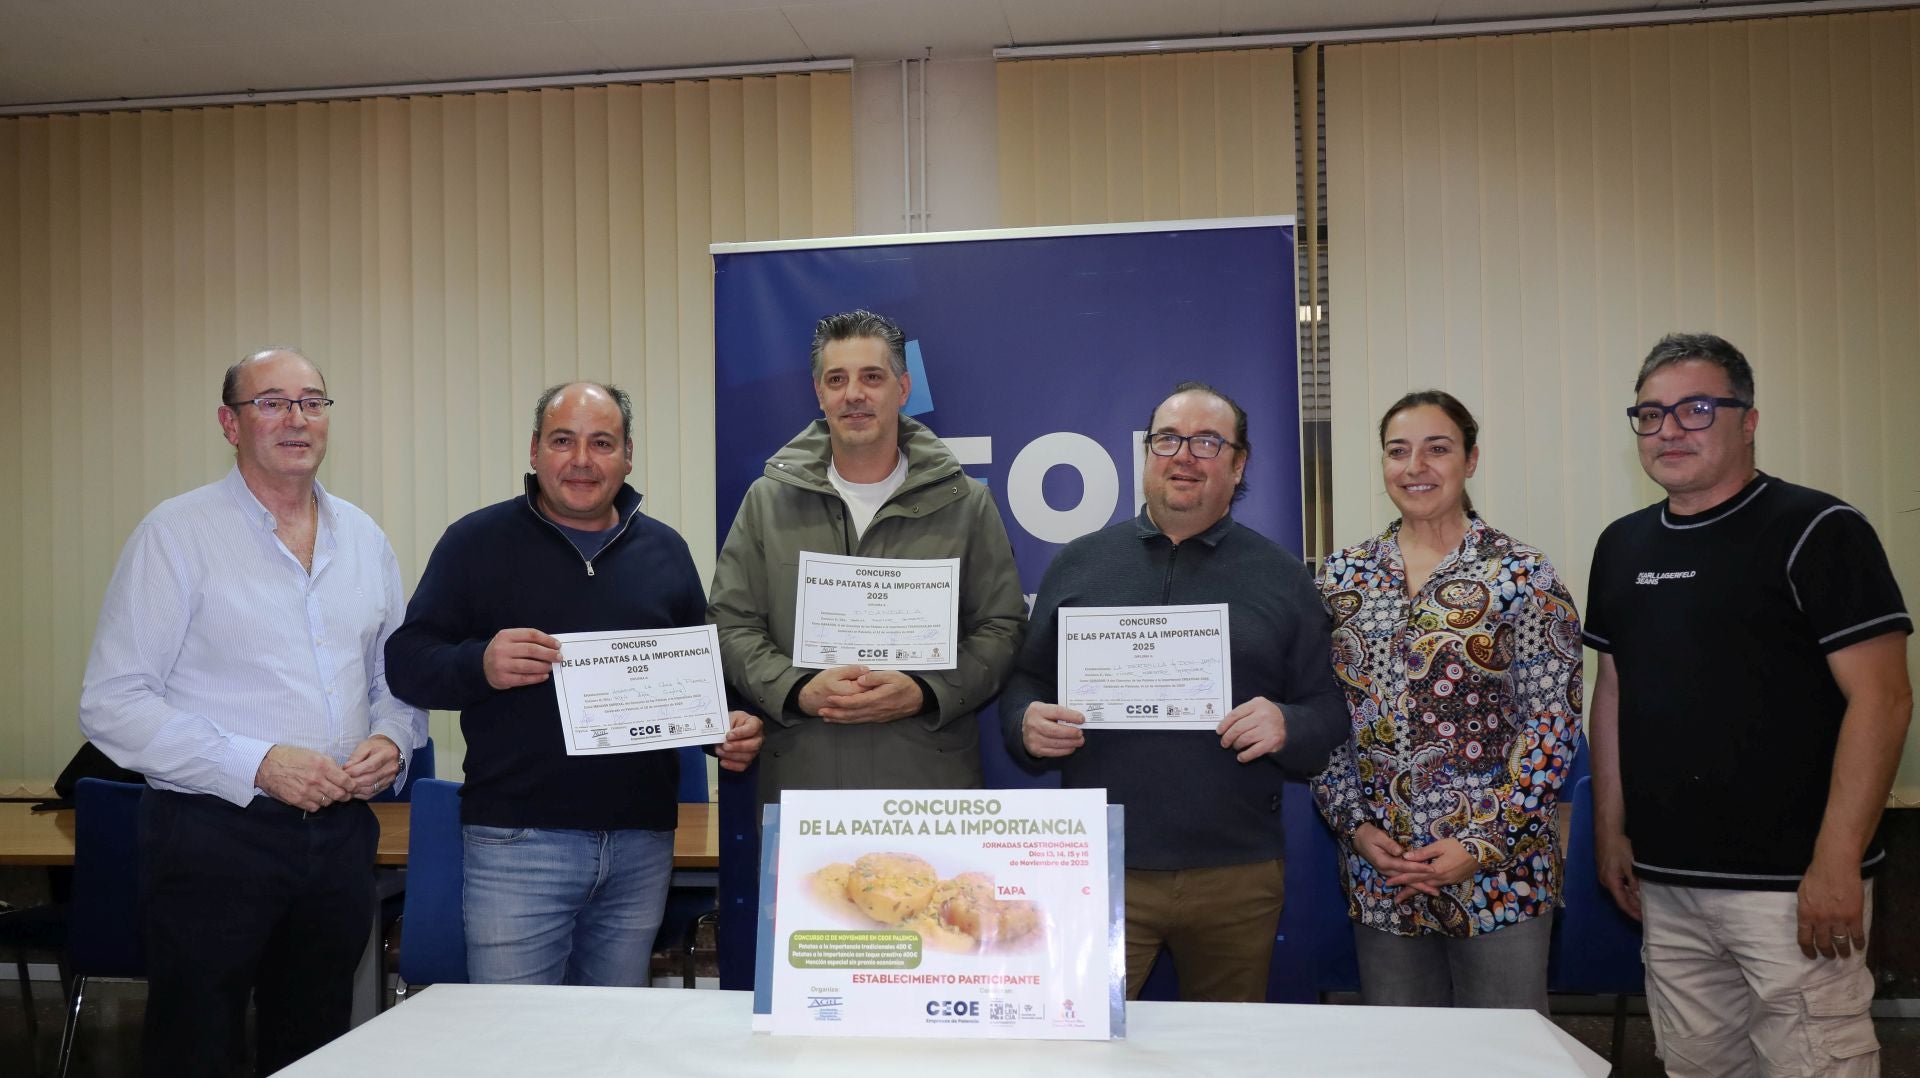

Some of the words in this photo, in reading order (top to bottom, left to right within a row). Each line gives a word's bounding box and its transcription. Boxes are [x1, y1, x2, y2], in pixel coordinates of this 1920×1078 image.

[855, 568, 901, 578] CONCURSO
[1638, 571, 1655, 579] KARL
[1656, 570, 1696, 579] LAGERFELD
[806, 576, 817, 585] DE
[819, 577, 834, 586] LAS
[836, 579, 872, 589] PATATAS
[882, 582, 891, 590] LA
[894, 581, 950, 590] IMPORTANCIA
[867, 592, 888, 600] 2025
[1119, 617, 1167, 626] CONCURSO
[1067, 633, 1079, 641] DE
[1081, 632, 1097, 641] LAS
[1099, 631, 1137, 640] PATATAS
[1139, 631, 1145, 639] A
[1148, 631, 1158, 639] LA
[1161, 628, 1220, 639] IMPORTANCIA
[611, 639, 657, 651] CONCURSO
[1132, 643, 1155, 651] 2025
[561, 659, 573, 668] DE
[575, 657, 591, 667] LAS
[593, 653, 631, 666] PATATAS
[632, 653, 638, 662] A
[640, 652, 650, 661] LA
[652, 647, 710, 660] IMPORTANCIA
[858, 649, 888, 658] CEOE
[627, 665, 649, 674] 2025
[1126, 704, 1158, 714] CEOE
[630, 724, 662, 737] CEOE
[883, 798, 1002, 816] CONCURSO
[799, 819, 822, 836] DE
[826, 819, 847, 836] LA
[851, 819, 914, 836] PATATA
[917, 819, 931, 836] A
[934, 819, 956, 836] LA
[961, 818, 1087, 836] IMPORTANCIA
[982, 841, 1021, 849] JORNADAS
[1023, 840, 1089, 849] GASTRONÓMICAS
[997, 886, 1026, 895] TAPA
[1081, 886, 1091, 895] €
[852, 974, 956, 984] ESTABLECIMIENTO
[959, 974, 1040, 985] PARTICIPANTE
[926, 1000, 979, 1016] CEOE
